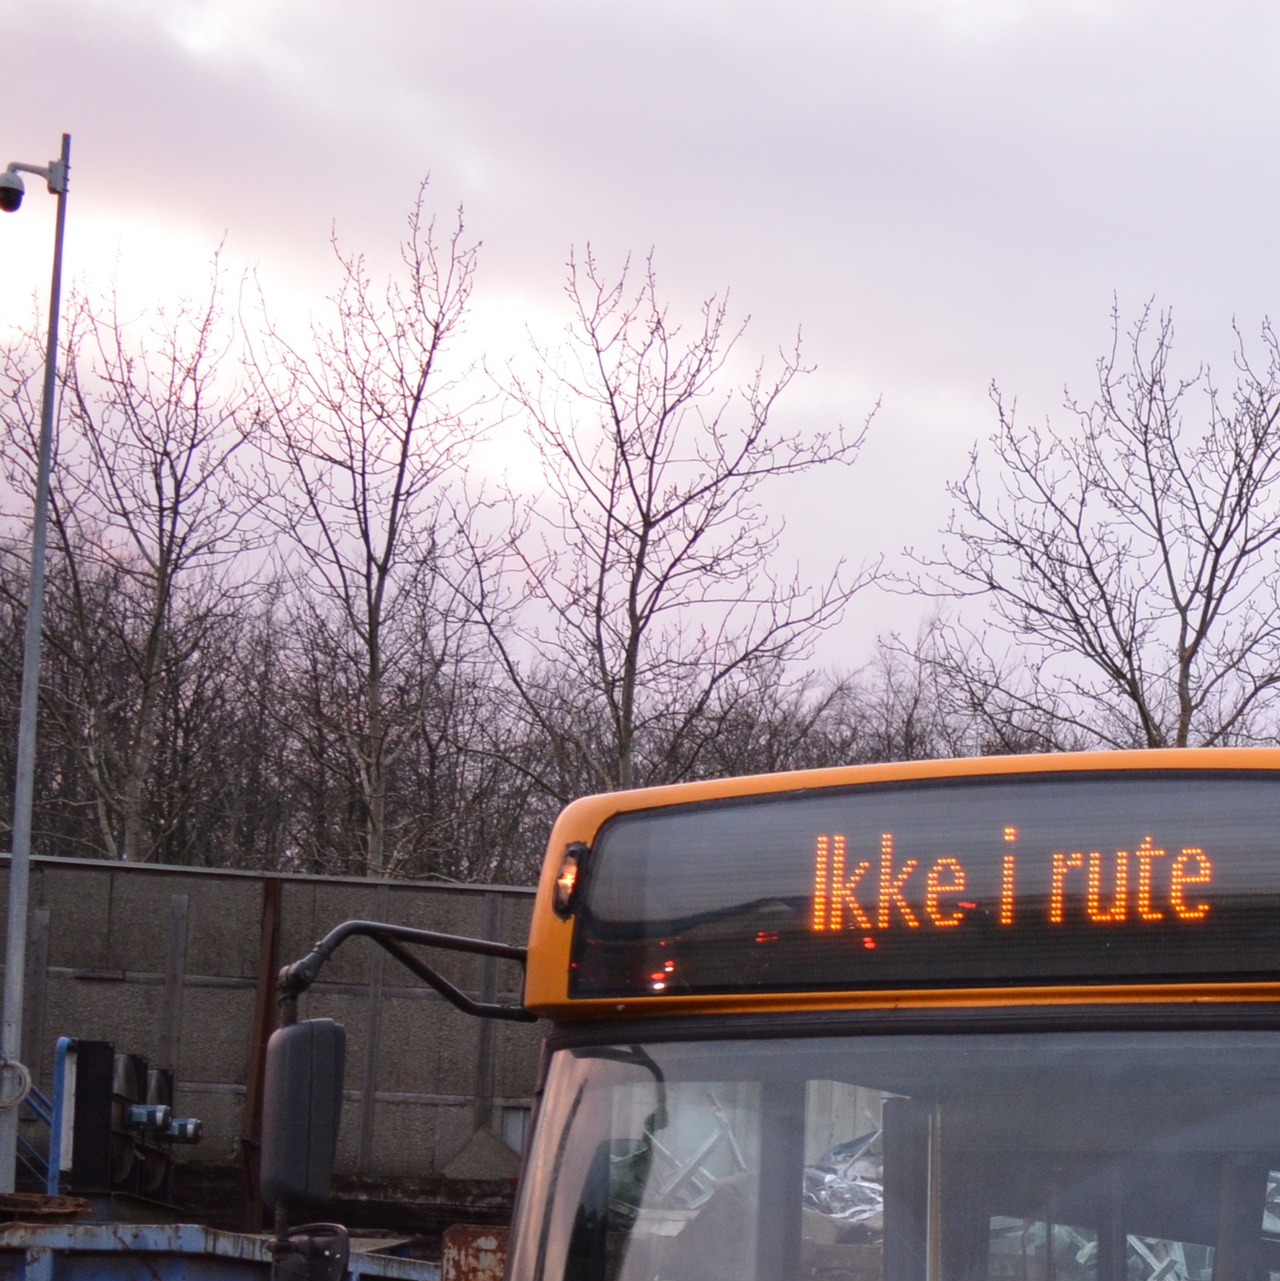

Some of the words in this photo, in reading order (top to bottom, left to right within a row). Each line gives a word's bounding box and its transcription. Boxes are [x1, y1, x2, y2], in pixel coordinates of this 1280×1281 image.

[812, 833, 966, 931] Ikke
[1001, 825, 1017, 925] i
[1050, 835, 1212, 926] rute
